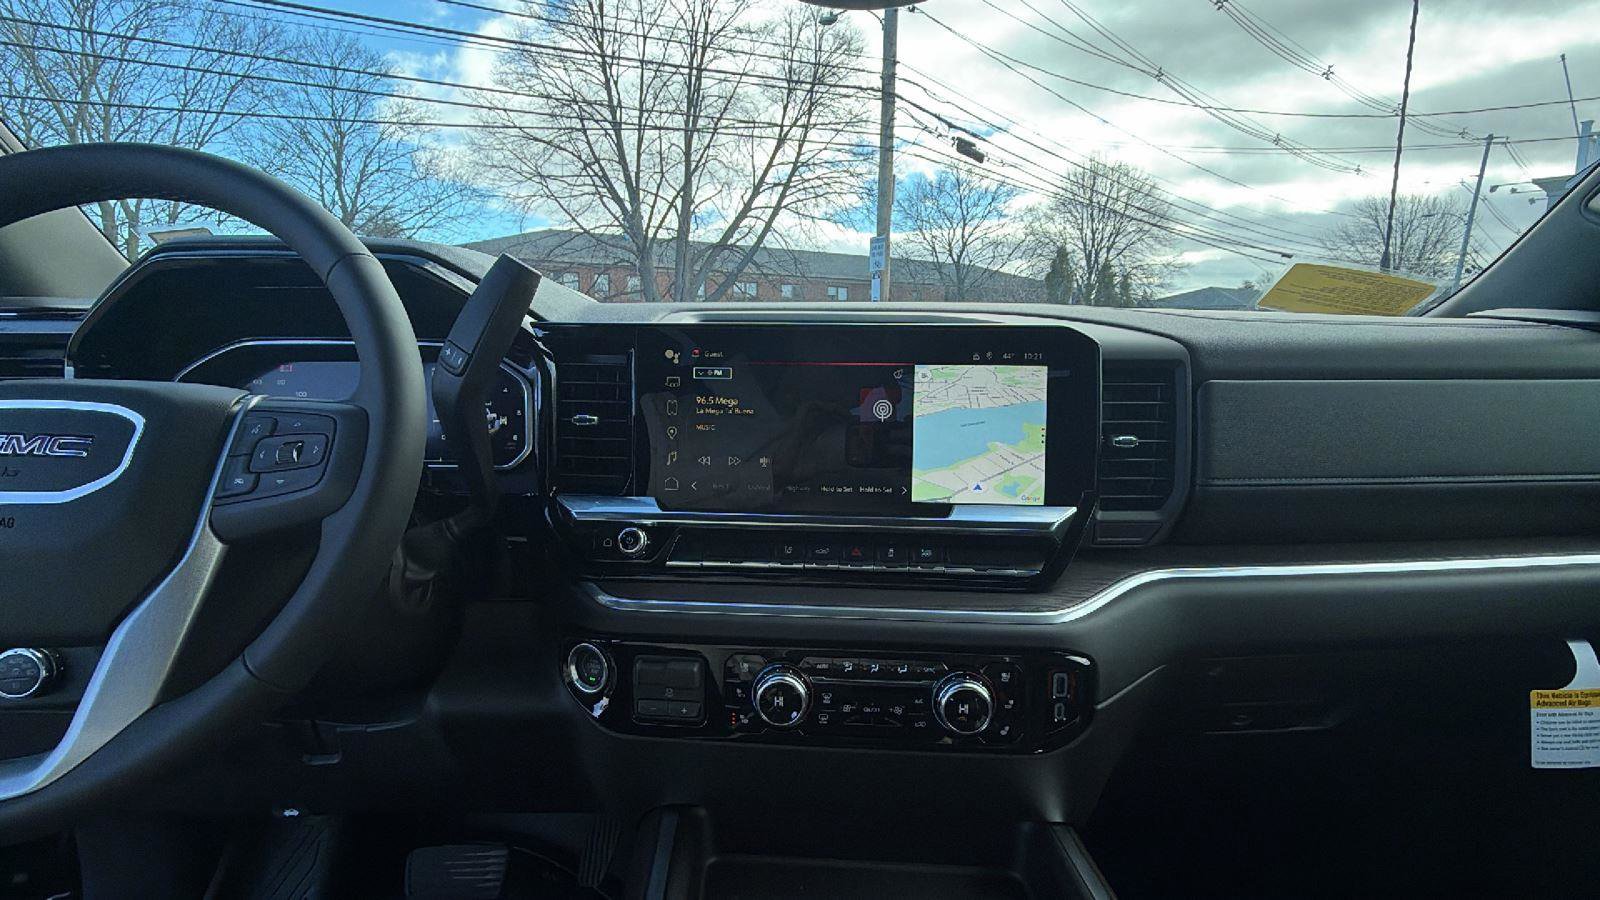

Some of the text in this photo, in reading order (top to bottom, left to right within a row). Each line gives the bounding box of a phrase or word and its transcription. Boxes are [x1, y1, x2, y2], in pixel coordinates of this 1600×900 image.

[704, 350, 724, 358] Guest
[1024, 352, 1042, 360] 10:21
[696, 396, 739, 407] 96.5 Mega
[859, 485, 874, 493] Hold
[1536, 699, 1568, 707] Advanced
